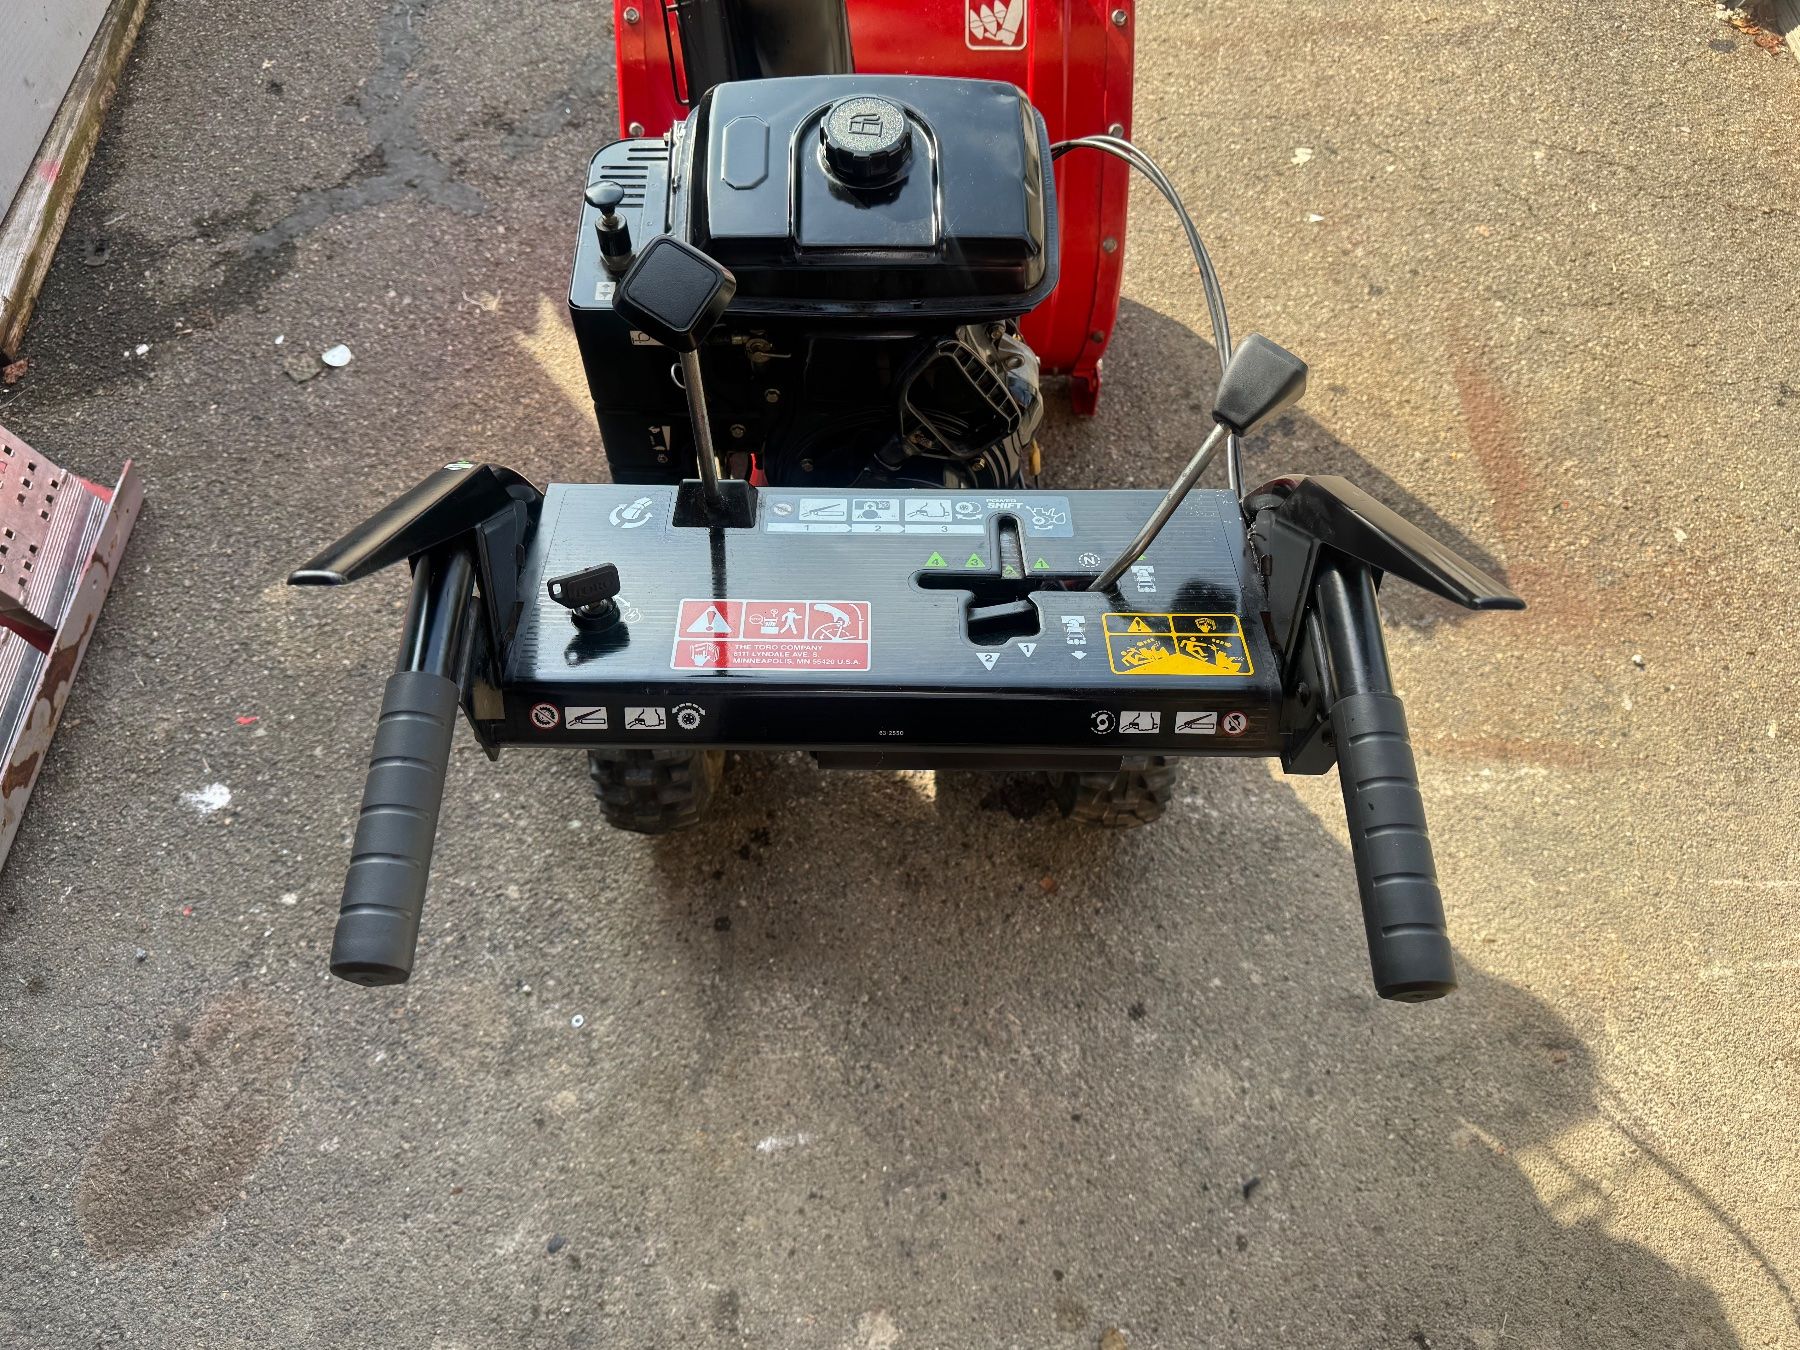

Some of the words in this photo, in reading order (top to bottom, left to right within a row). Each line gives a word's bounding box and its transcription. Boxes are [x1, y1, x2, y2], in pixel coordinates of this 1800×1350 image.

[941, 525, 948, 533] 3
[931, 558, 940, 566] 4
[970, 558, 979, 567] 3
[1038, 560, 1044, 568] 1
[1084, 556, 1096, 565] N
[1023, 645, 1030, 653] 1
[984, 653, 993, 662] 2
